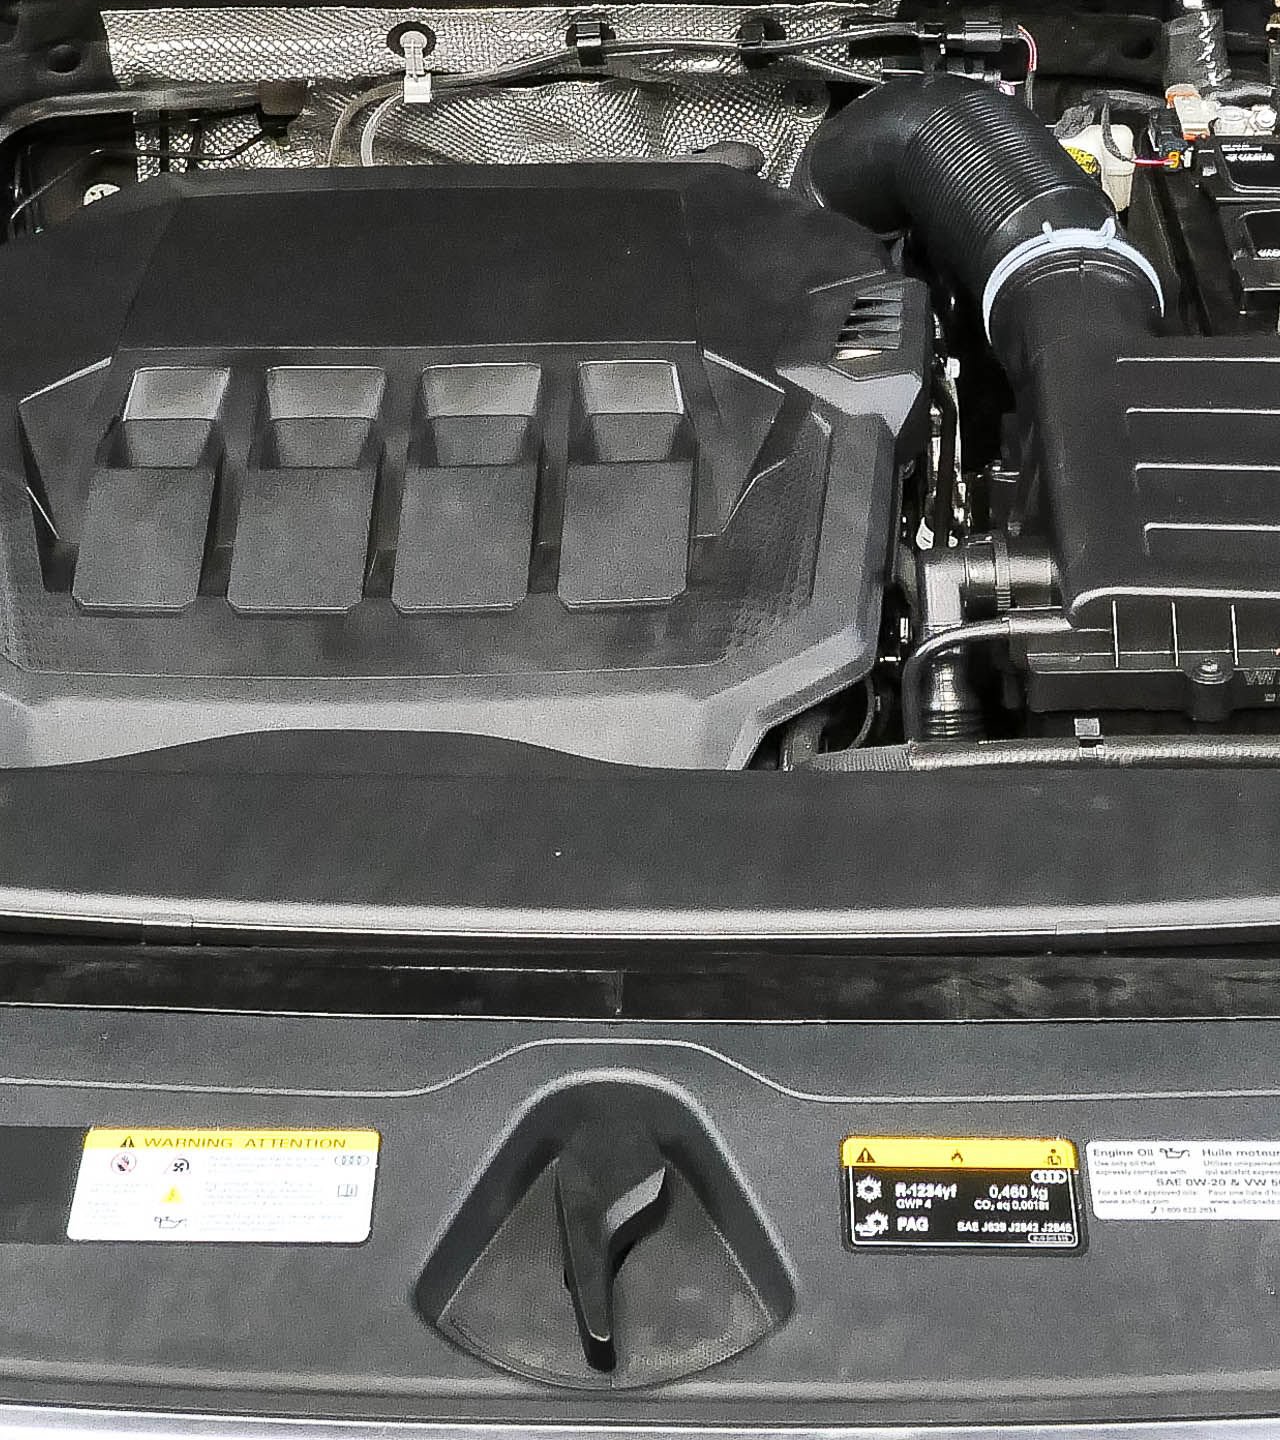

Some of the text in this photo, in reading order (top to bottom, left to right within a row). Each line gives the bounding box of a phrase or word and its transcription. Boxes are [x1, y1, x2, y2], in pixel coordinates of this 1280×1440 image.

[143, 1137, 347, 1148] WARNING ATTENTION
[1093, 1148, 1154, 1158] Engine Oil
[1202, 1148, 1280, 1157] Huile moteur
[1156, 1178, 1182, 1187] SAE
[1185, 1178, 1227, 1187] 0W-20
[1230, 1178, 1240, 1187] &
[1244, 1178, 1268, 1187] VW
[1030, 1184, 1049, 1201] kg
[896, 1197, 932, 1209] GWP 4
[897, 1215, 929, 1232] PAG
[956, 1220, 979, 1233] SAE
